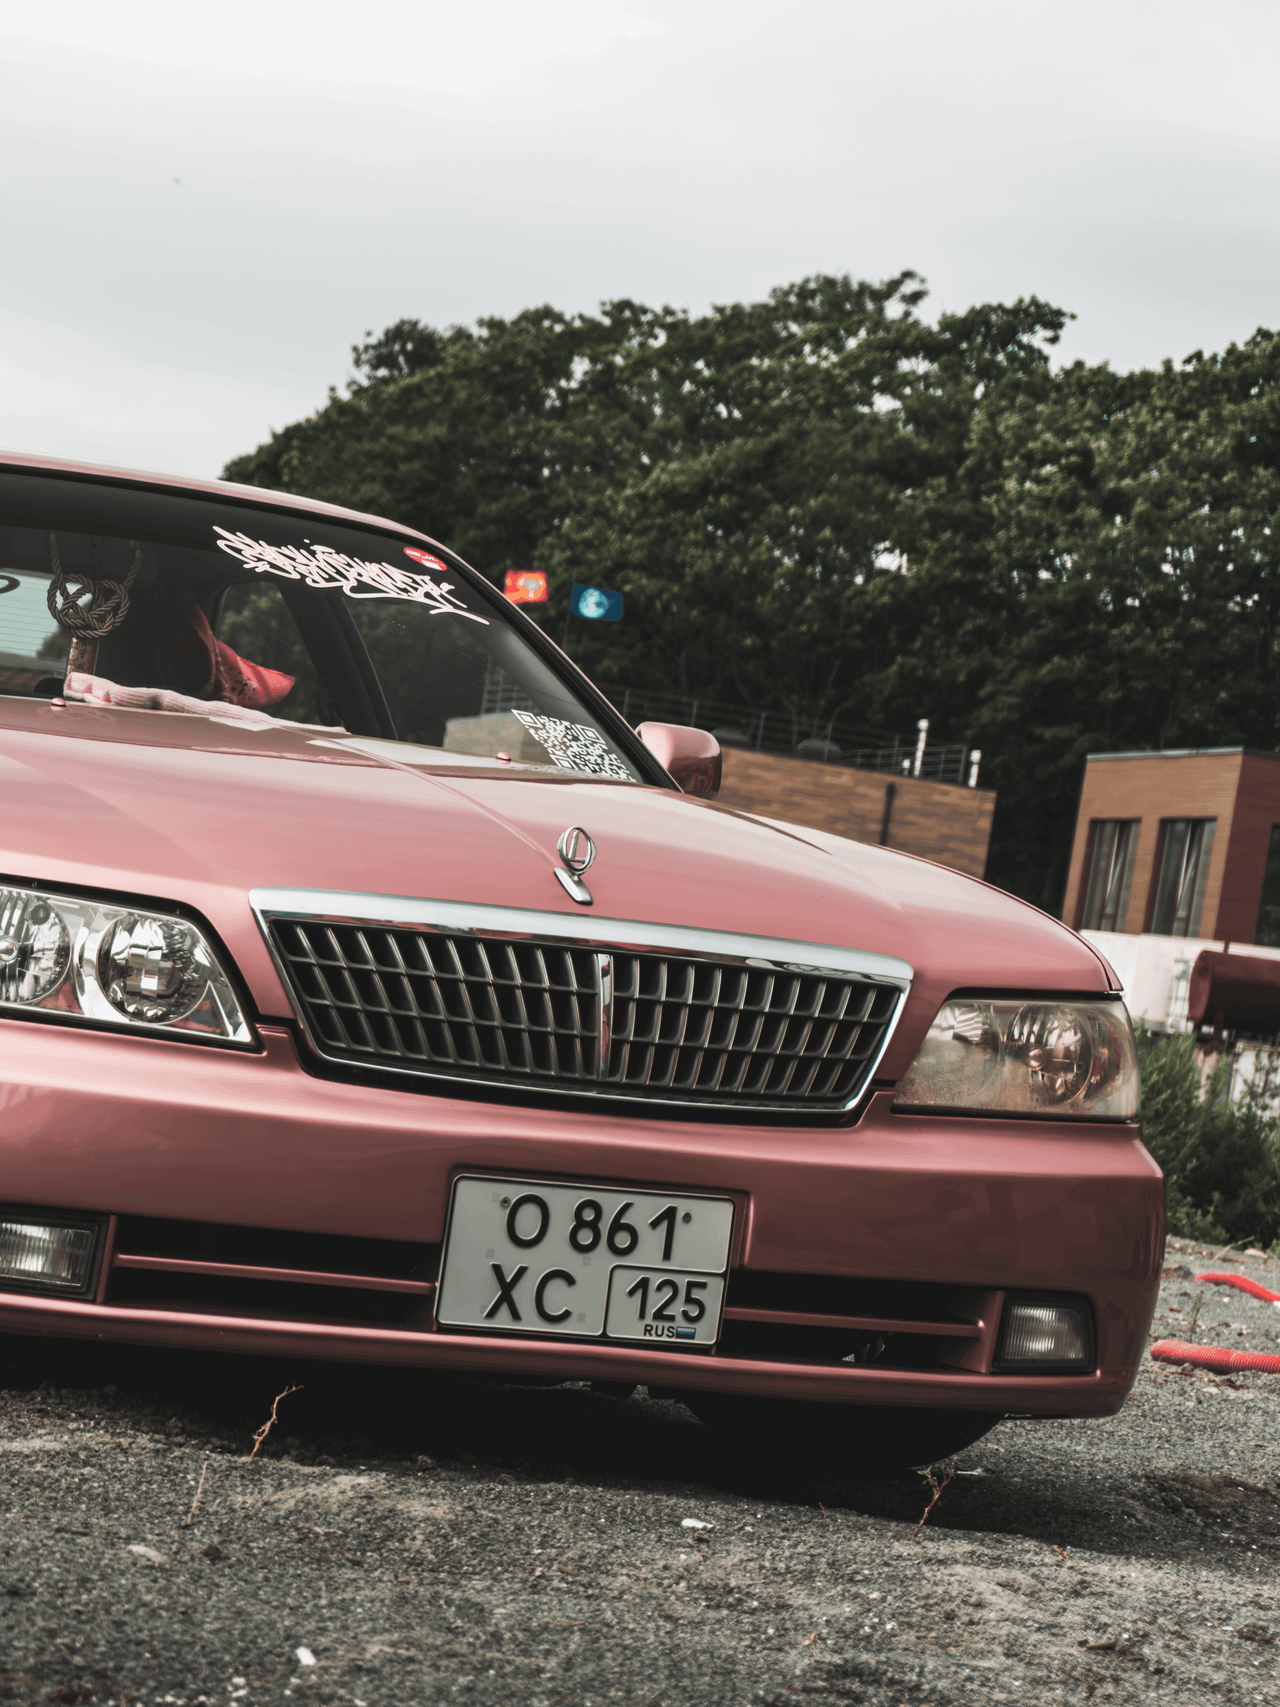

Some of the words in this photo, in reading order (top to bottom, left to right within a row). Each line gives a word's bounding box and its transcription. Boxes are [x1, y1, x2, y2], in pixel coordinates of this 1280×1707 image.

[568, 1197, 679, 1262] 861
[482, 1262, 577, 1324] XC
[625, 1275, 708, 1323] 125
[643, 1323, 676, 1339] RUS
